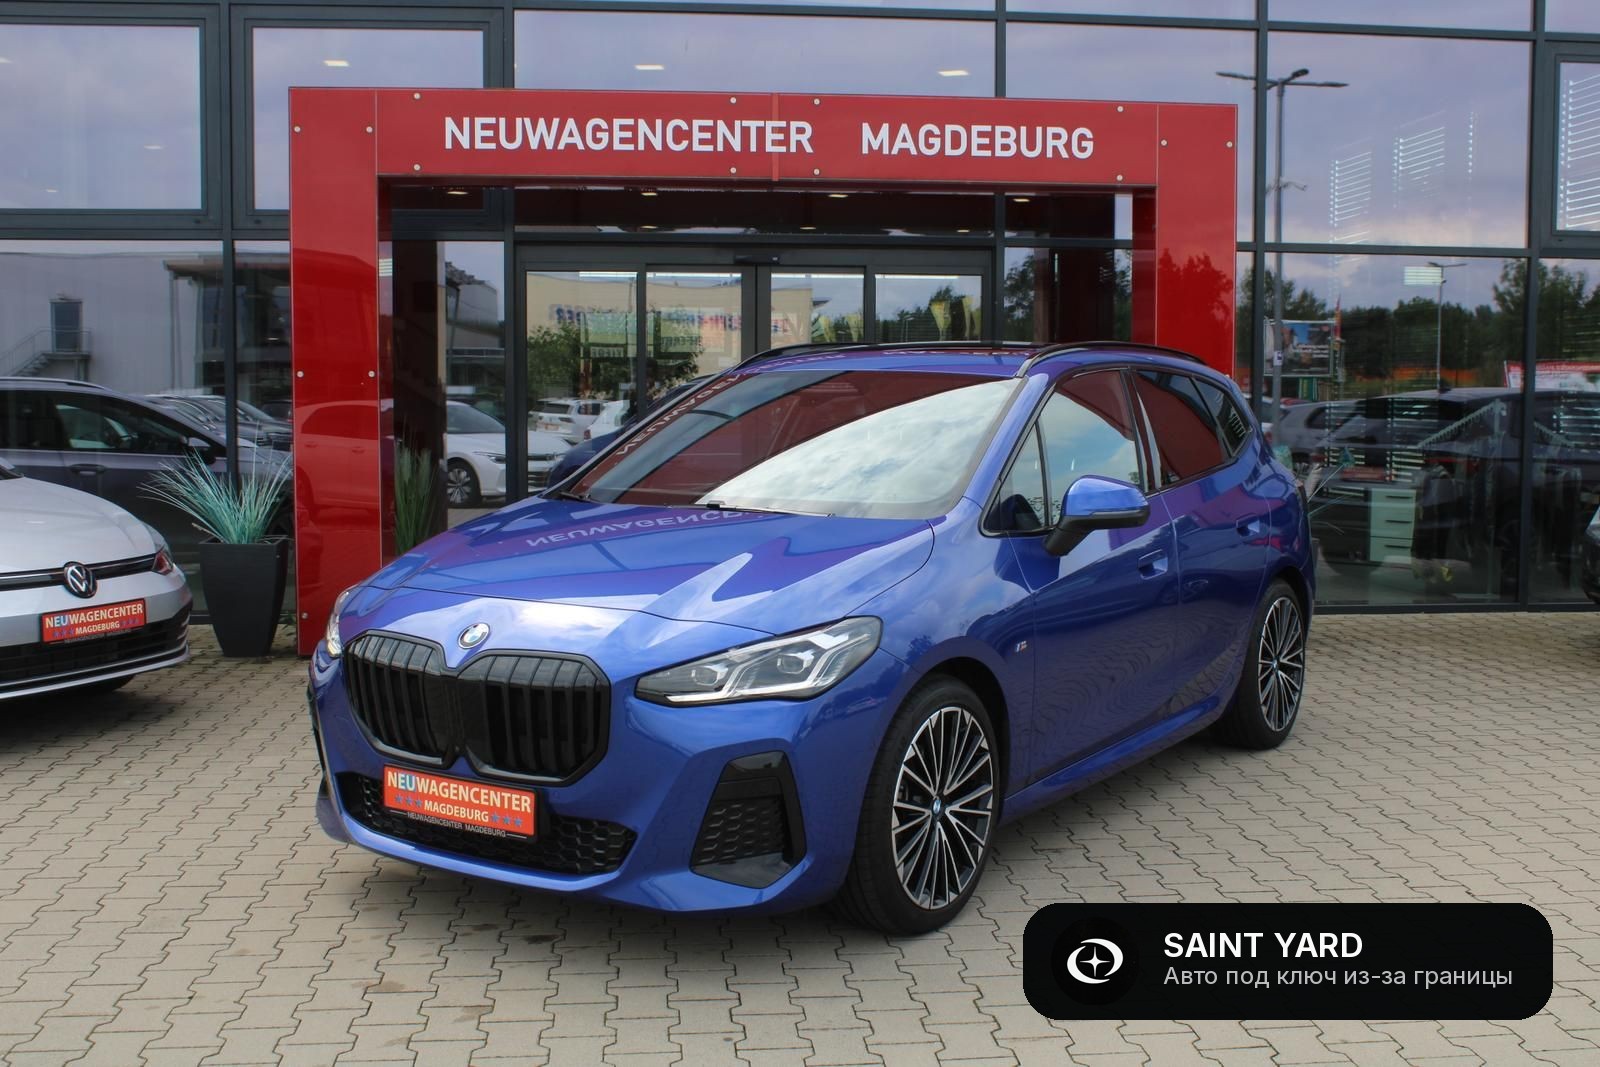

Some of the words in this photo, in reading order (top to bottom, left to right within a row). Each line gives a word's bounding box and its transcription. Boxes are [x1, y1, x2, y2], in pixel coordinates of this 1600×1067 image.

[444, 116, 814, 154] NEUWAGENCENTER
[861, 122, 1095, 160] MAGDEBURG
[45, 603, 143, 628] NEUWAGENCENTER
[75, 621, 120, 634] MAGDEBURG
[387, 771, 531, 813] NEUWAGENCENTER
[424, 799, 489, 823] MAGDEBURG
[407, 811, 463, 830] NEUWAGENCENTER
[464, 823, 506, 838] MAGDEBURG
